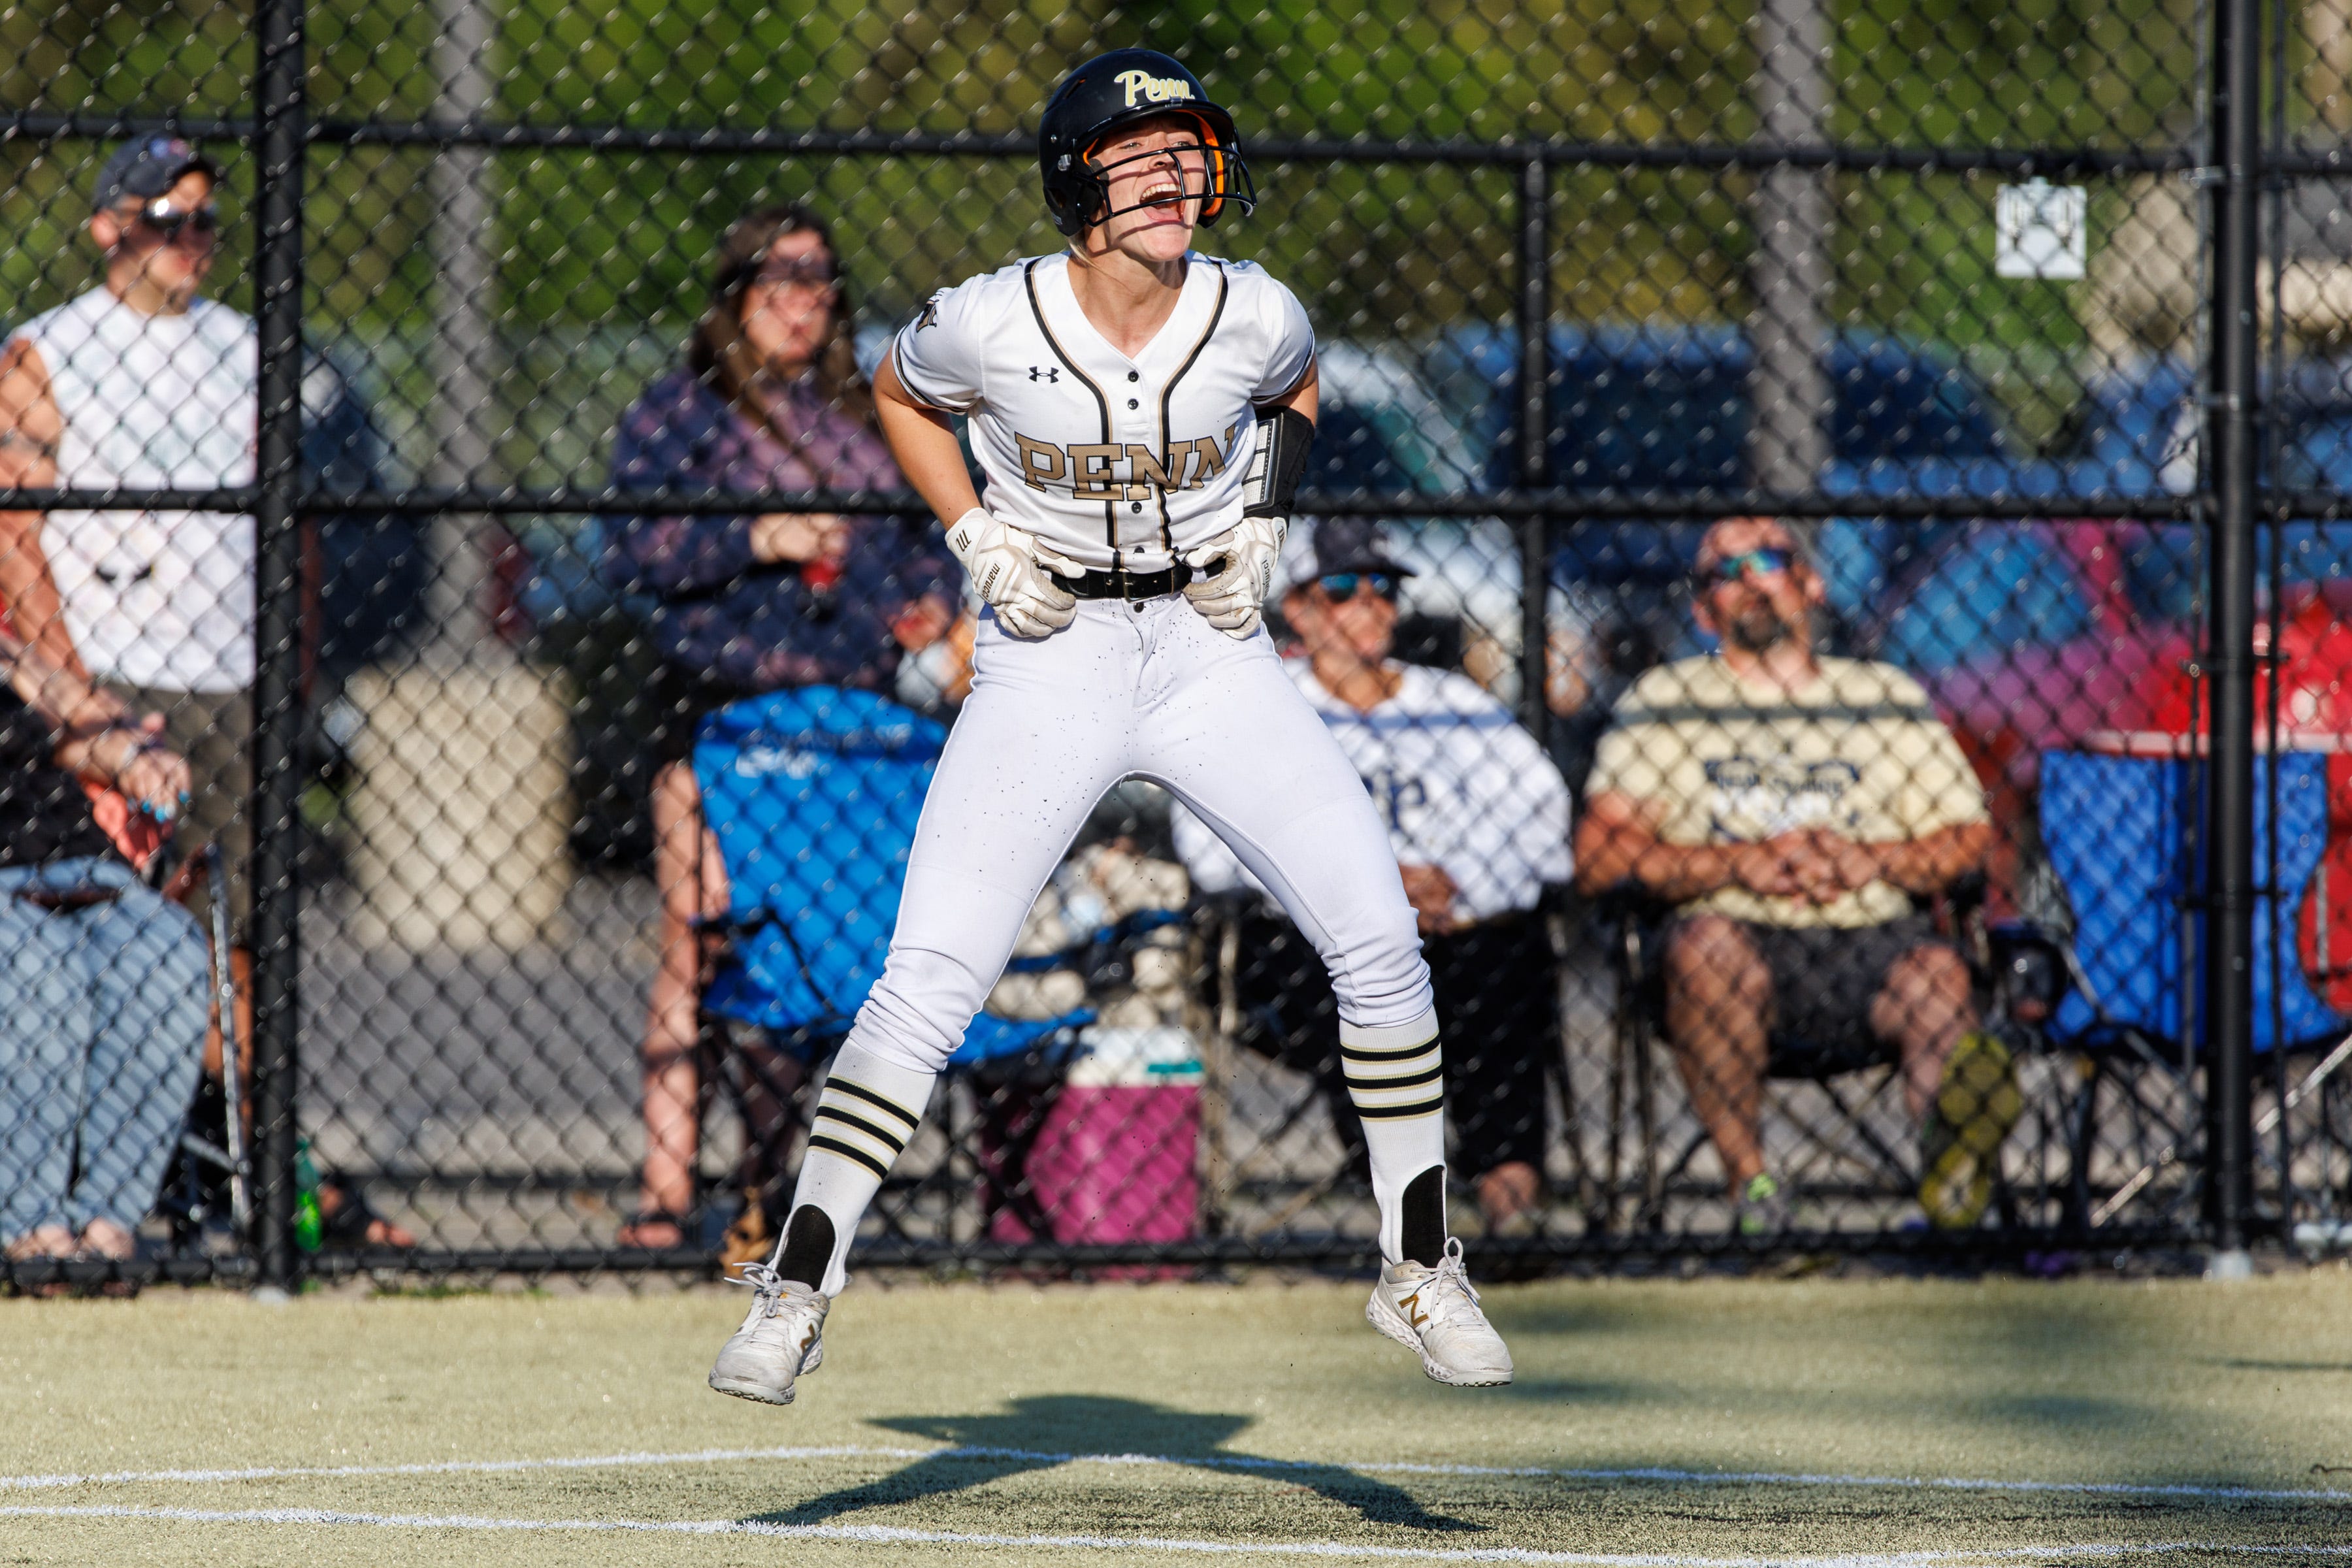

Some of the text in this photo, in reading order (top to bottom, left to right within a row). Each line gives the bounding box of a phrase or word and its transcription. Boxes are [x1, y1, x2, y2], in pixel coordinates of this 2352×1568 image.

[1114, 70, 1195, 106] Penn
[1014, 425, 1235, 501] PENN
[982, 563, 1001, 602] marucci
